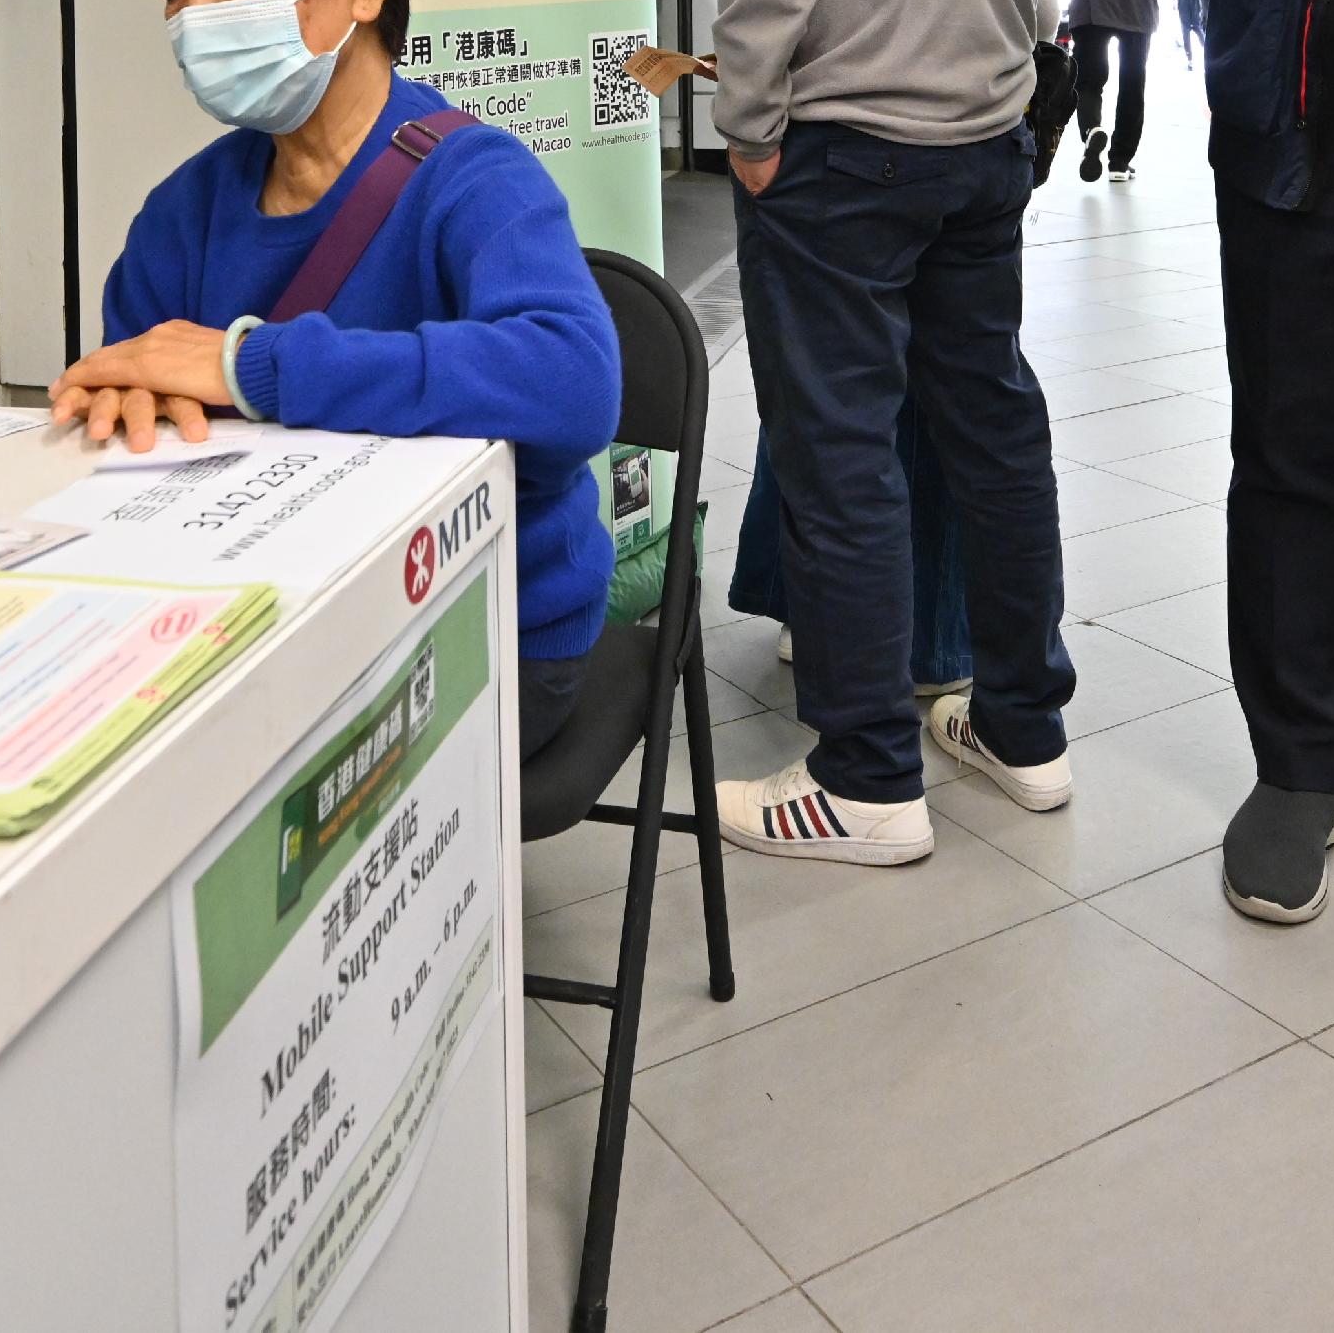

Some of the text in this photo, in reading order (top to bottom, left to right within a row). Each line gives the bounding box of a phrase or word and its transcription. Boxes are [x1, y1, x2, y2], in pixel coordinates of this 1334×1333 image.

[532, 136, 572, 155] Macao
[535, 112, 569, 133] travel
[182, 453, 319, 530] 3142 2330
[438, 480, 492, 568] MTR
[321, 796, 419, 966] 流動支援站
[259, 991, 335, 1120] Mobile
[337, 877, 408, 1004] Support
[410, 806, 460, 897] Station
[390, 996, 400, 1036] 9
[403, 959, 432, 1015] a.m.
[443, 907, 451, 943] 6
[452, 878, 478, 939] p.m.
[225, 1196, 298, 1332] Service
[302, 1103, 356, 1207] hours:
